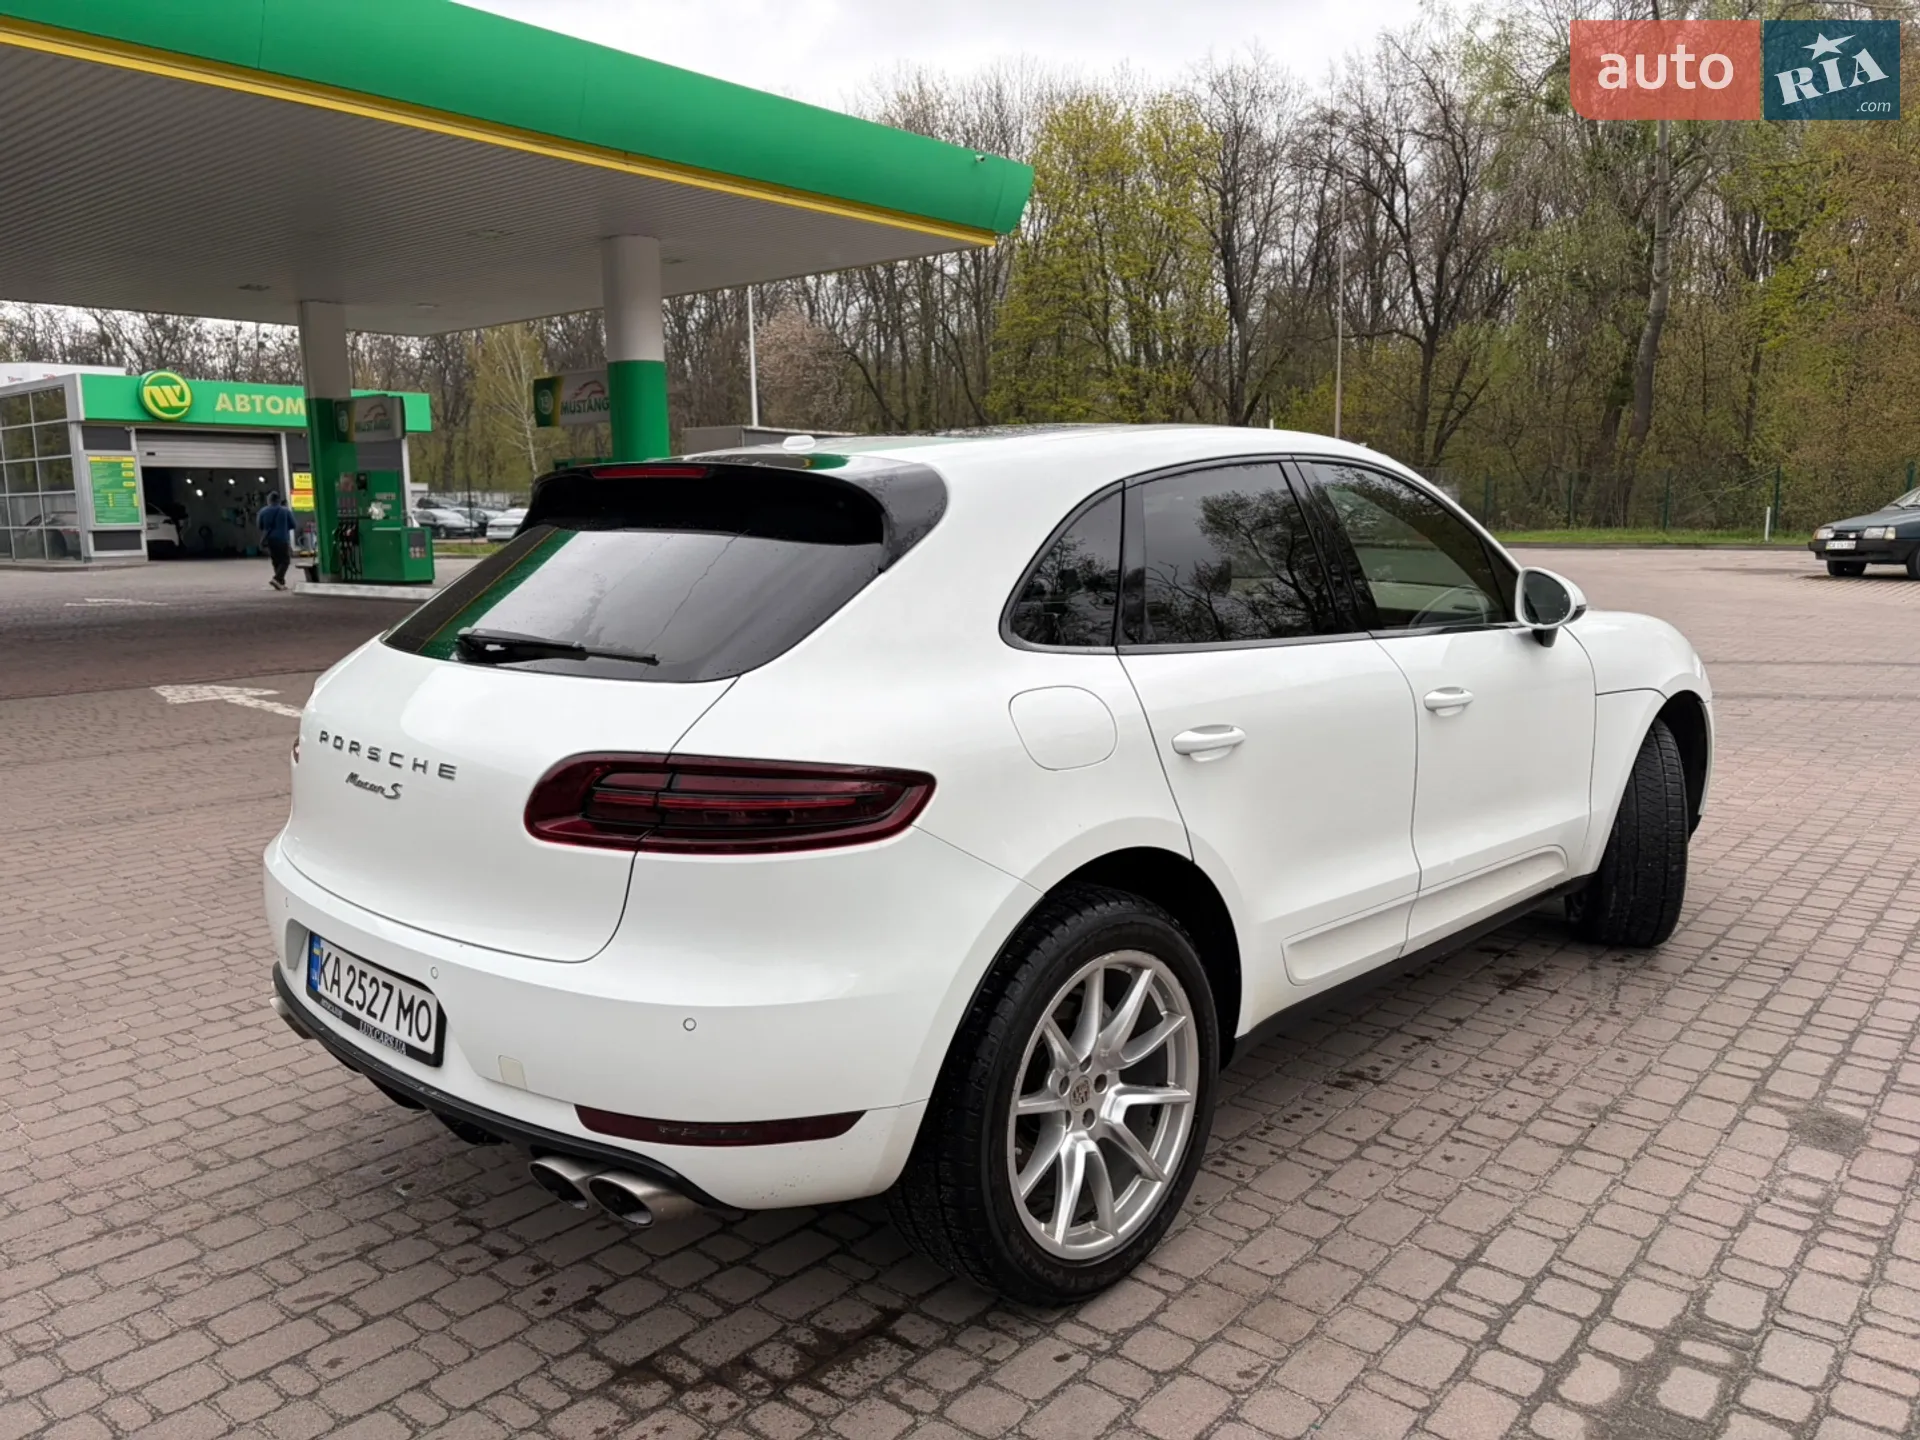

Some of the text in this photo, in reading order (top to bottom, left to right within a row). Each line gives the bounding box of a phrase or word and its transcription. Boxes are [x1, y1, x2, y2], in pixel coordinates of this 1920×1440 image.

[560, 396, 610, 416] MUSTANG
[319, 730, 457, 781] PORSCHE
[344, 964, 394, 1023] 2527
